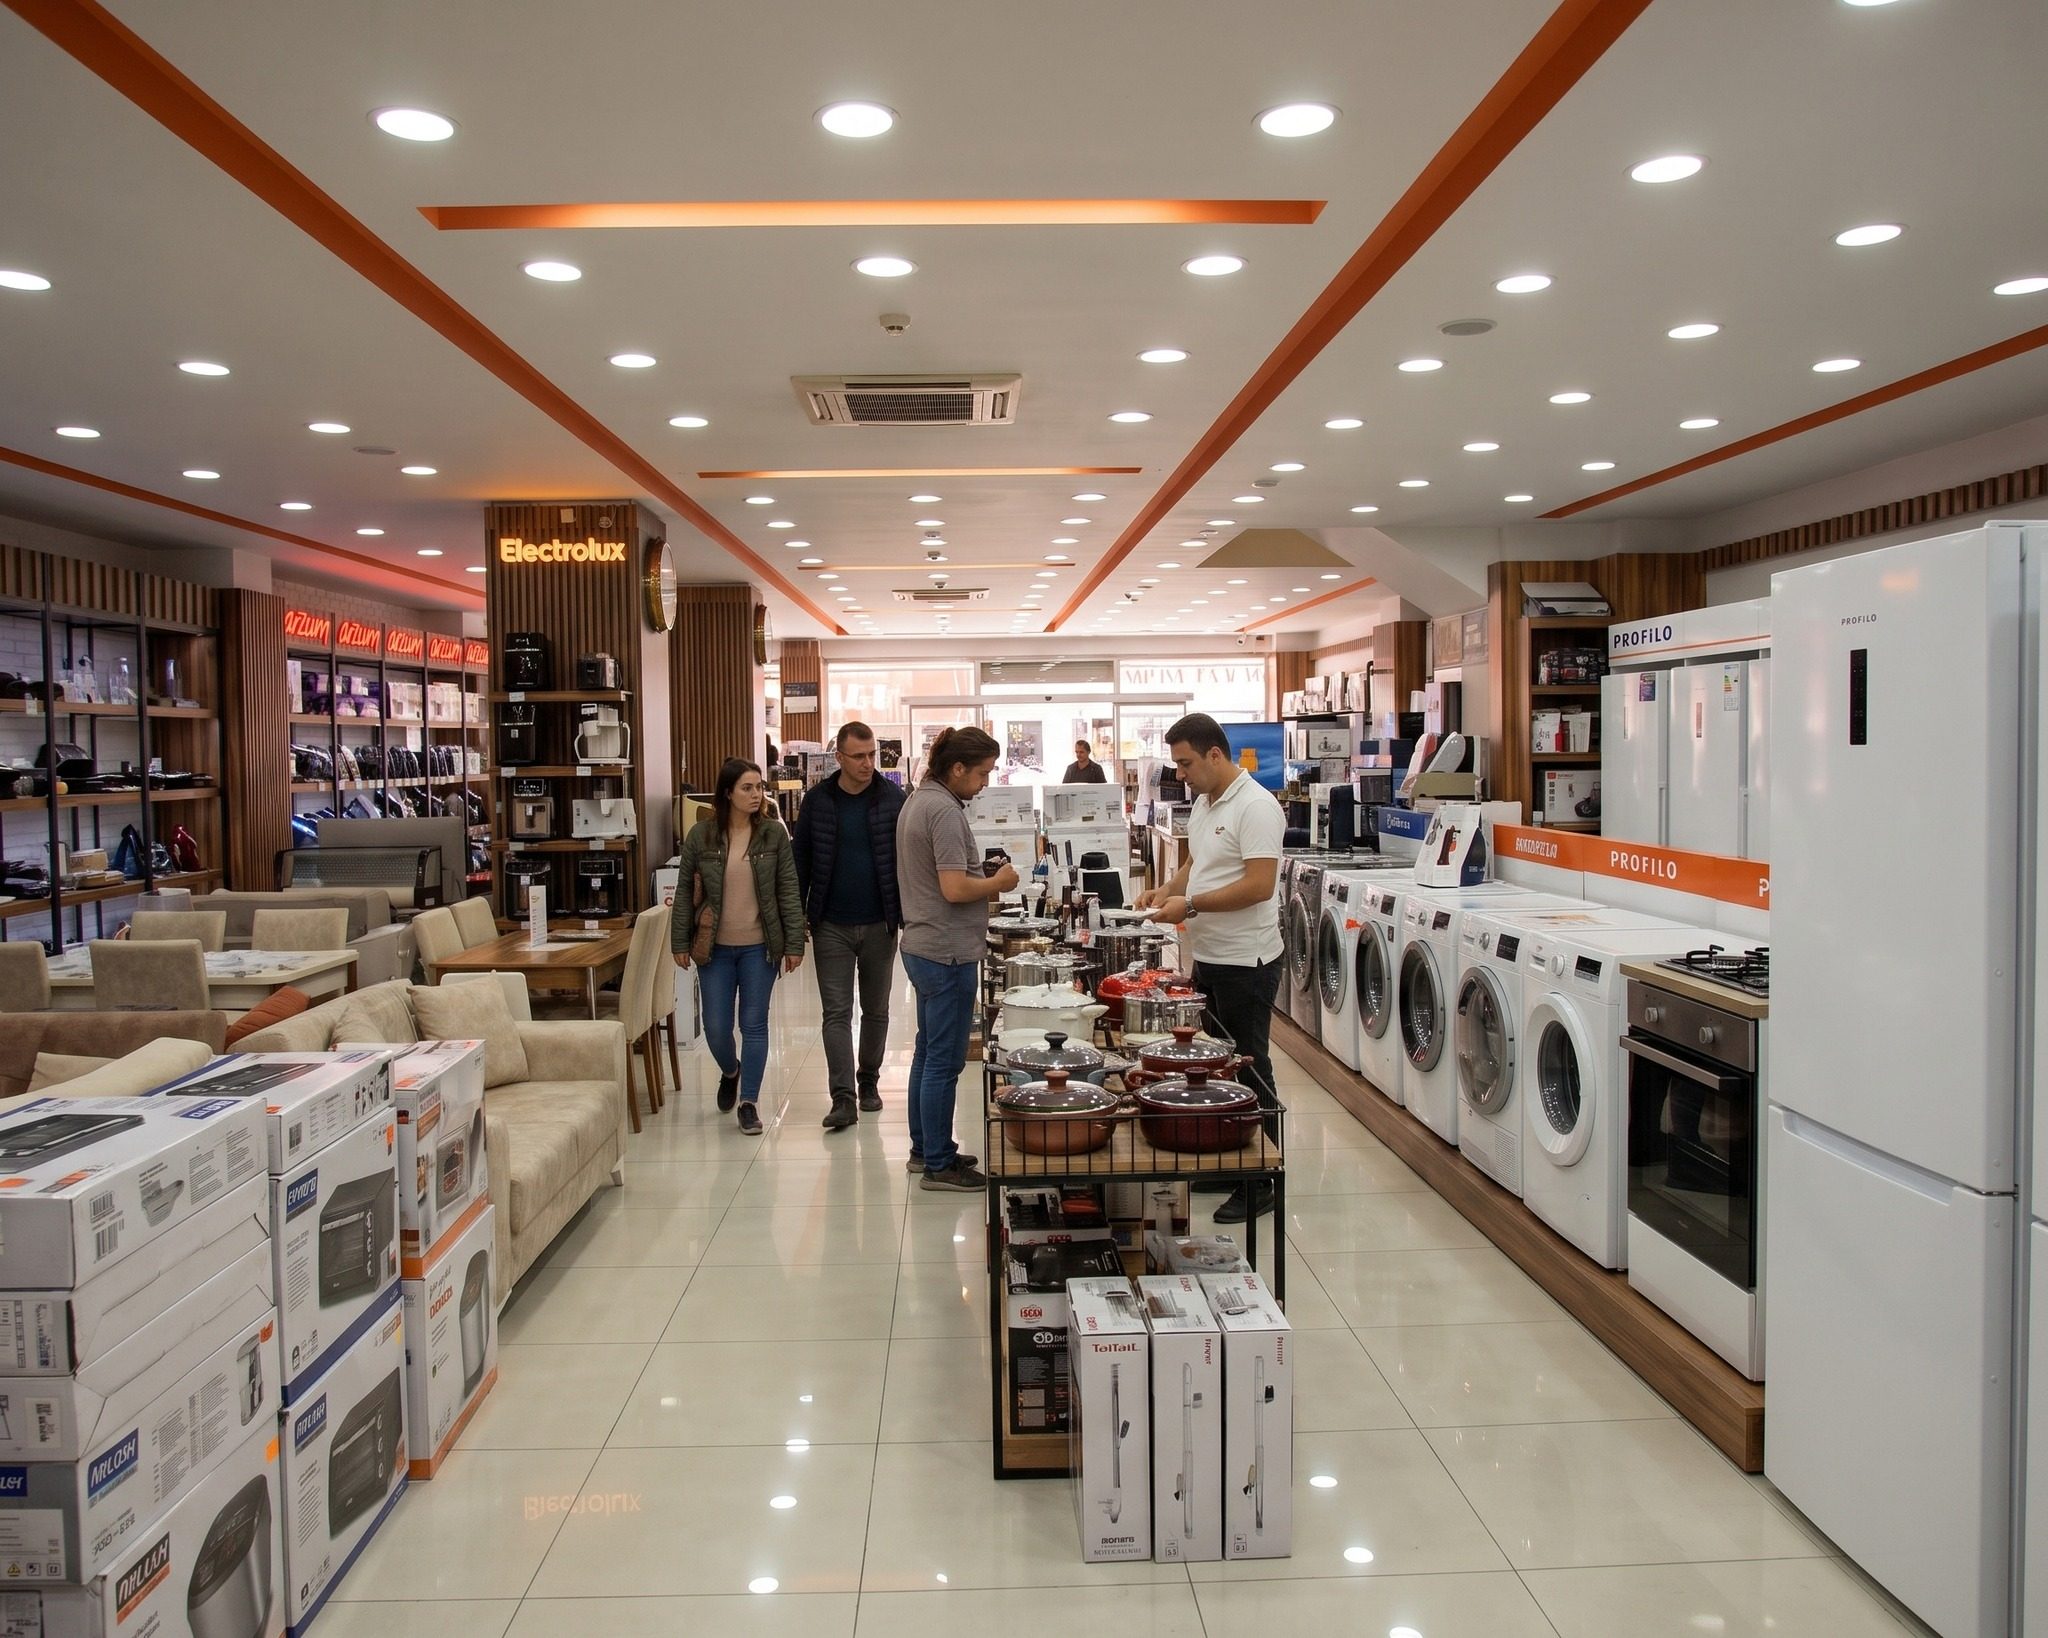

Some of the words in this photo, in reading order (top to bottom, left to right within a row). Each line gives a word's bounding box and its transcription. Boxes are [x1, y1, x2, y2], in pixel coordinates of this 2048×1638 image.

[500, 537, 626, 562] Electrolux
[1841, 614, 1877, 626] PROFILO
[1610, 850, 1677, 880] PROFILO
